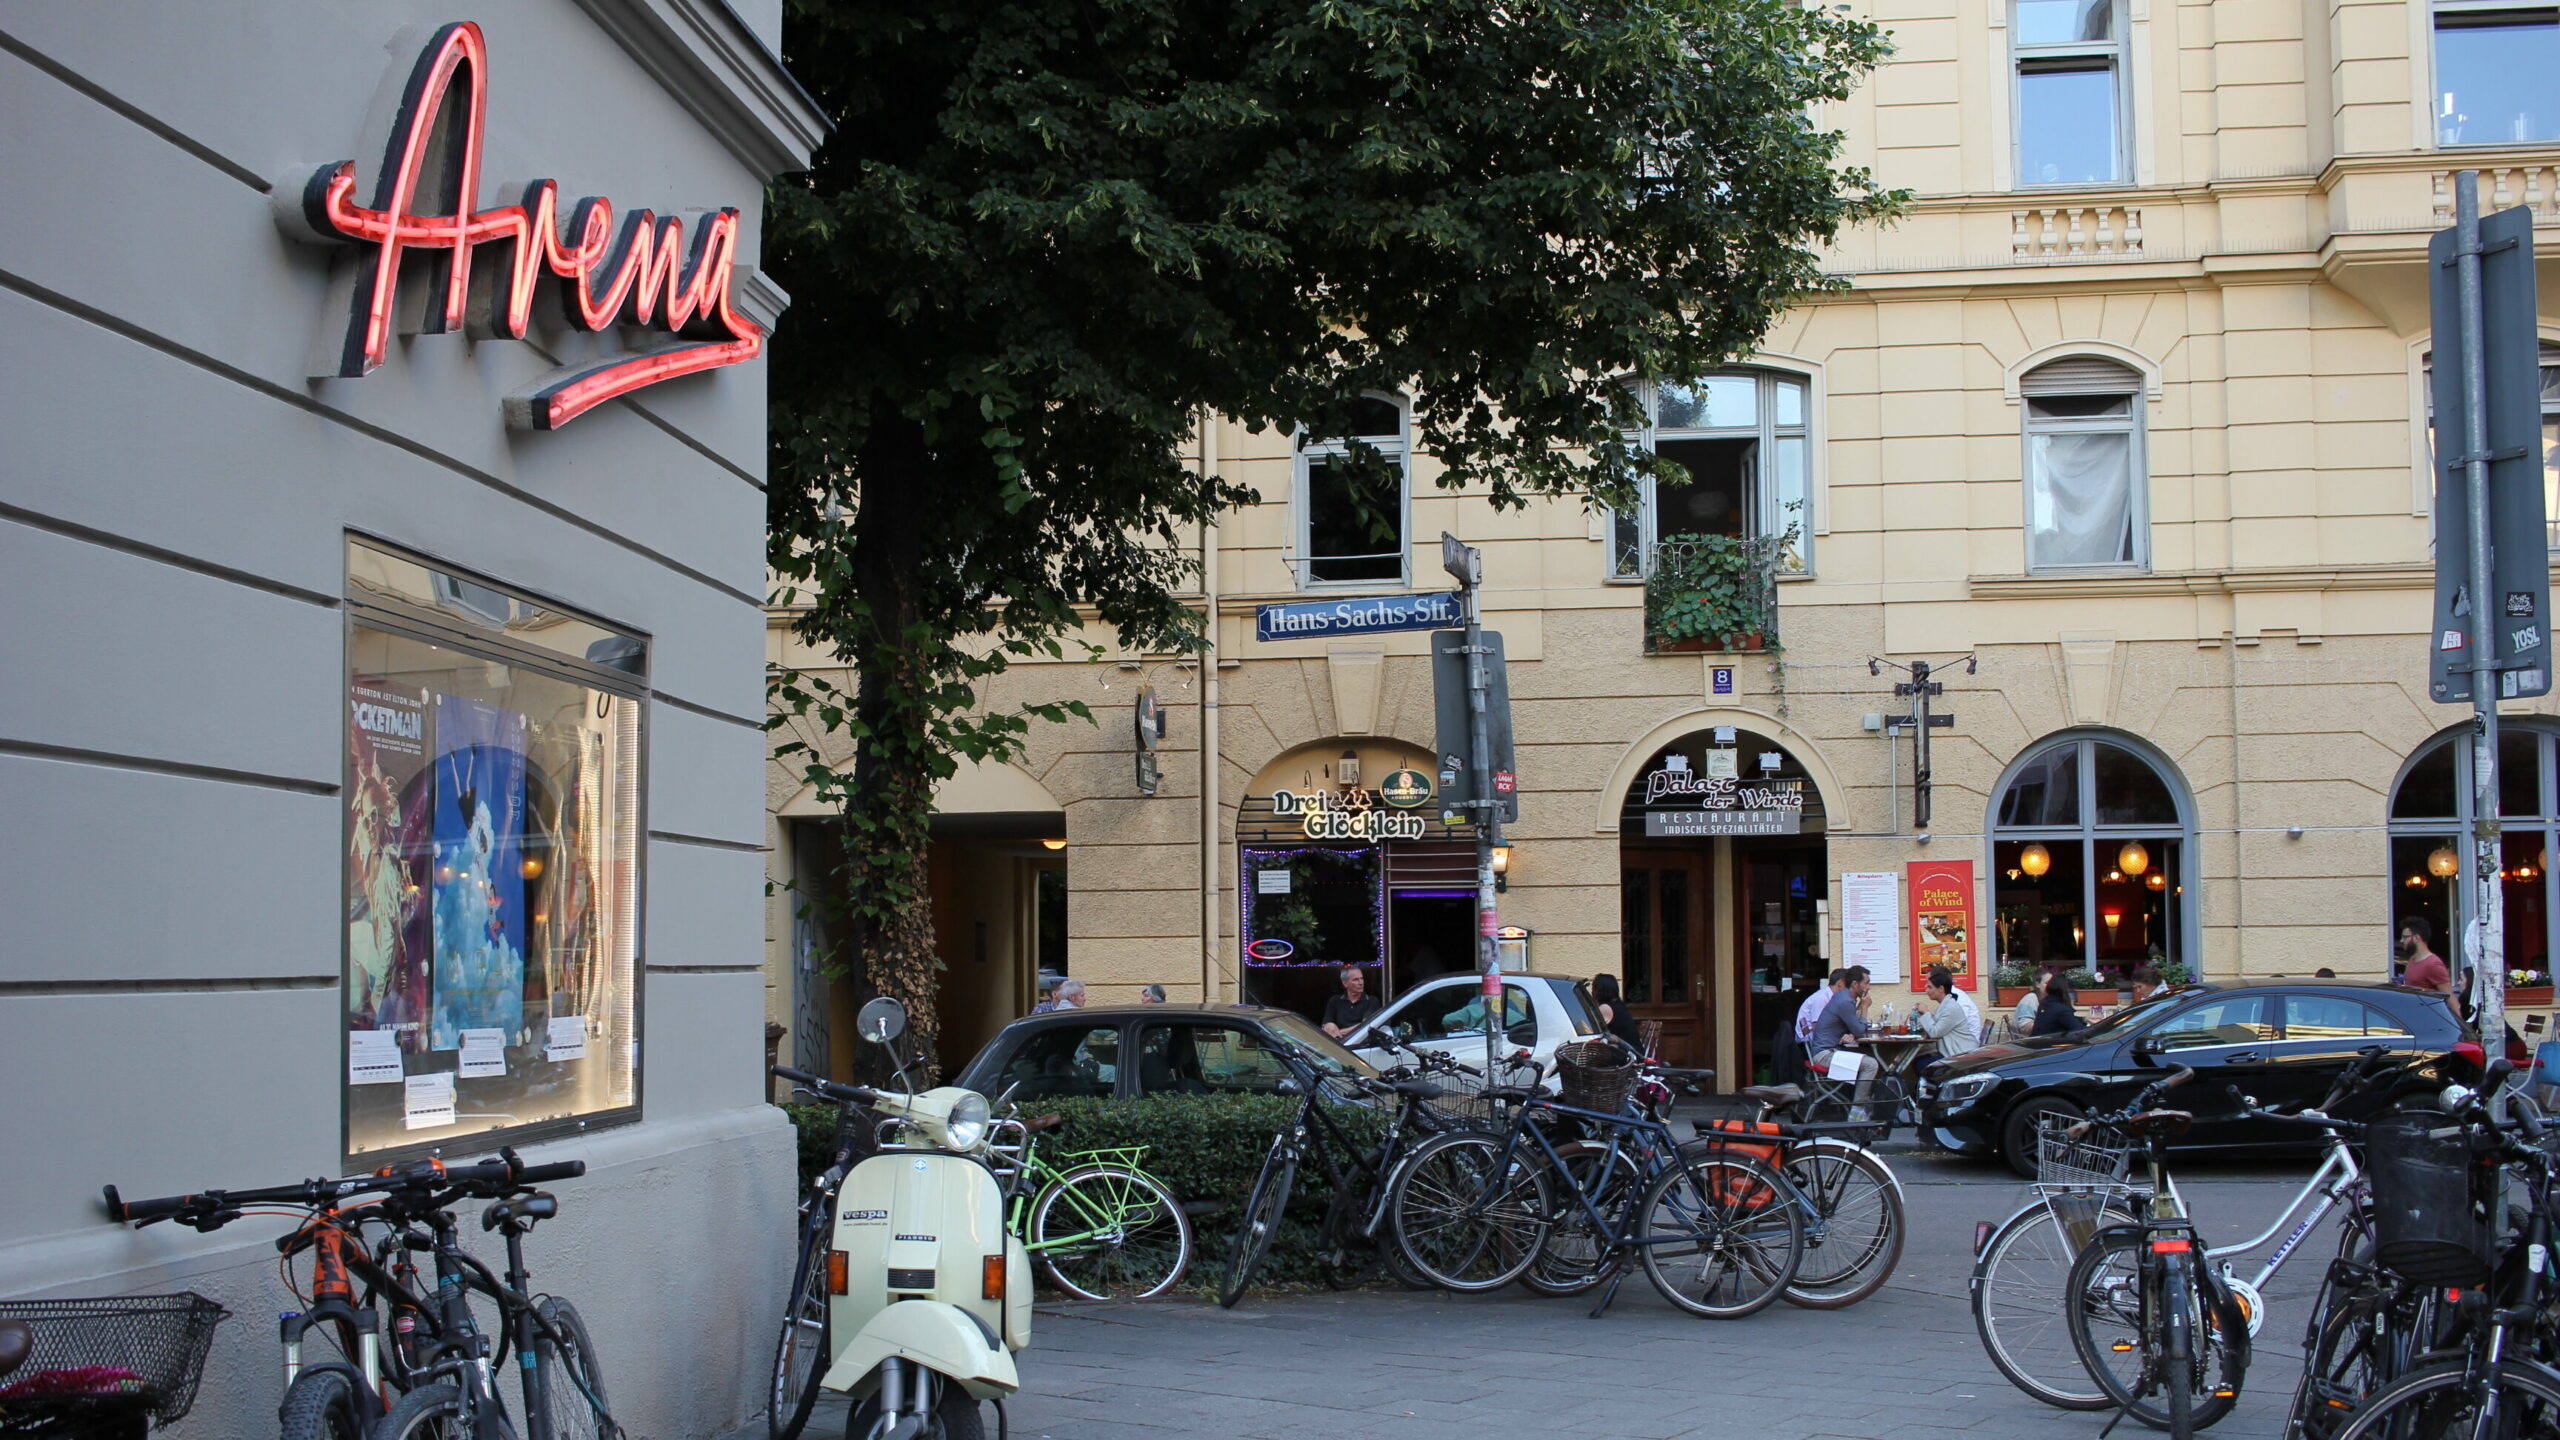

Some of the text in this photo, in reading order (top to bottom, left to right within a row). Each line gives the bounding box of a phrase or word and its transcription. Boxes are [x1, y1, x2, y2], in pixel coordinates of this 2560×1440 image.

[304, 21, 762, 430] Arena
[1268, 598, 1454, 633] Hans-Sachs-Str.
[1717, 670, 1728, 683] 8
[1646, 768, 1739, 805] Palast
[1274, 789, 1328, 815] Drei
[1703, 788, 1803, 809] der Winde
[1304, 810, 1425, 842] Glöcklein
[1660, 811, 1786, 823] RESTAURANT
[1665, 823, 1783, 834] INDISCHE SPEZIALITÄTEN
[1919, 897, 1963, 906] of Wind
[1923, 889, 1959, 898] Palace
[844, 1210, 886, 1220] vespa
[2267, 1221, 2308, 1267] KETTLER
